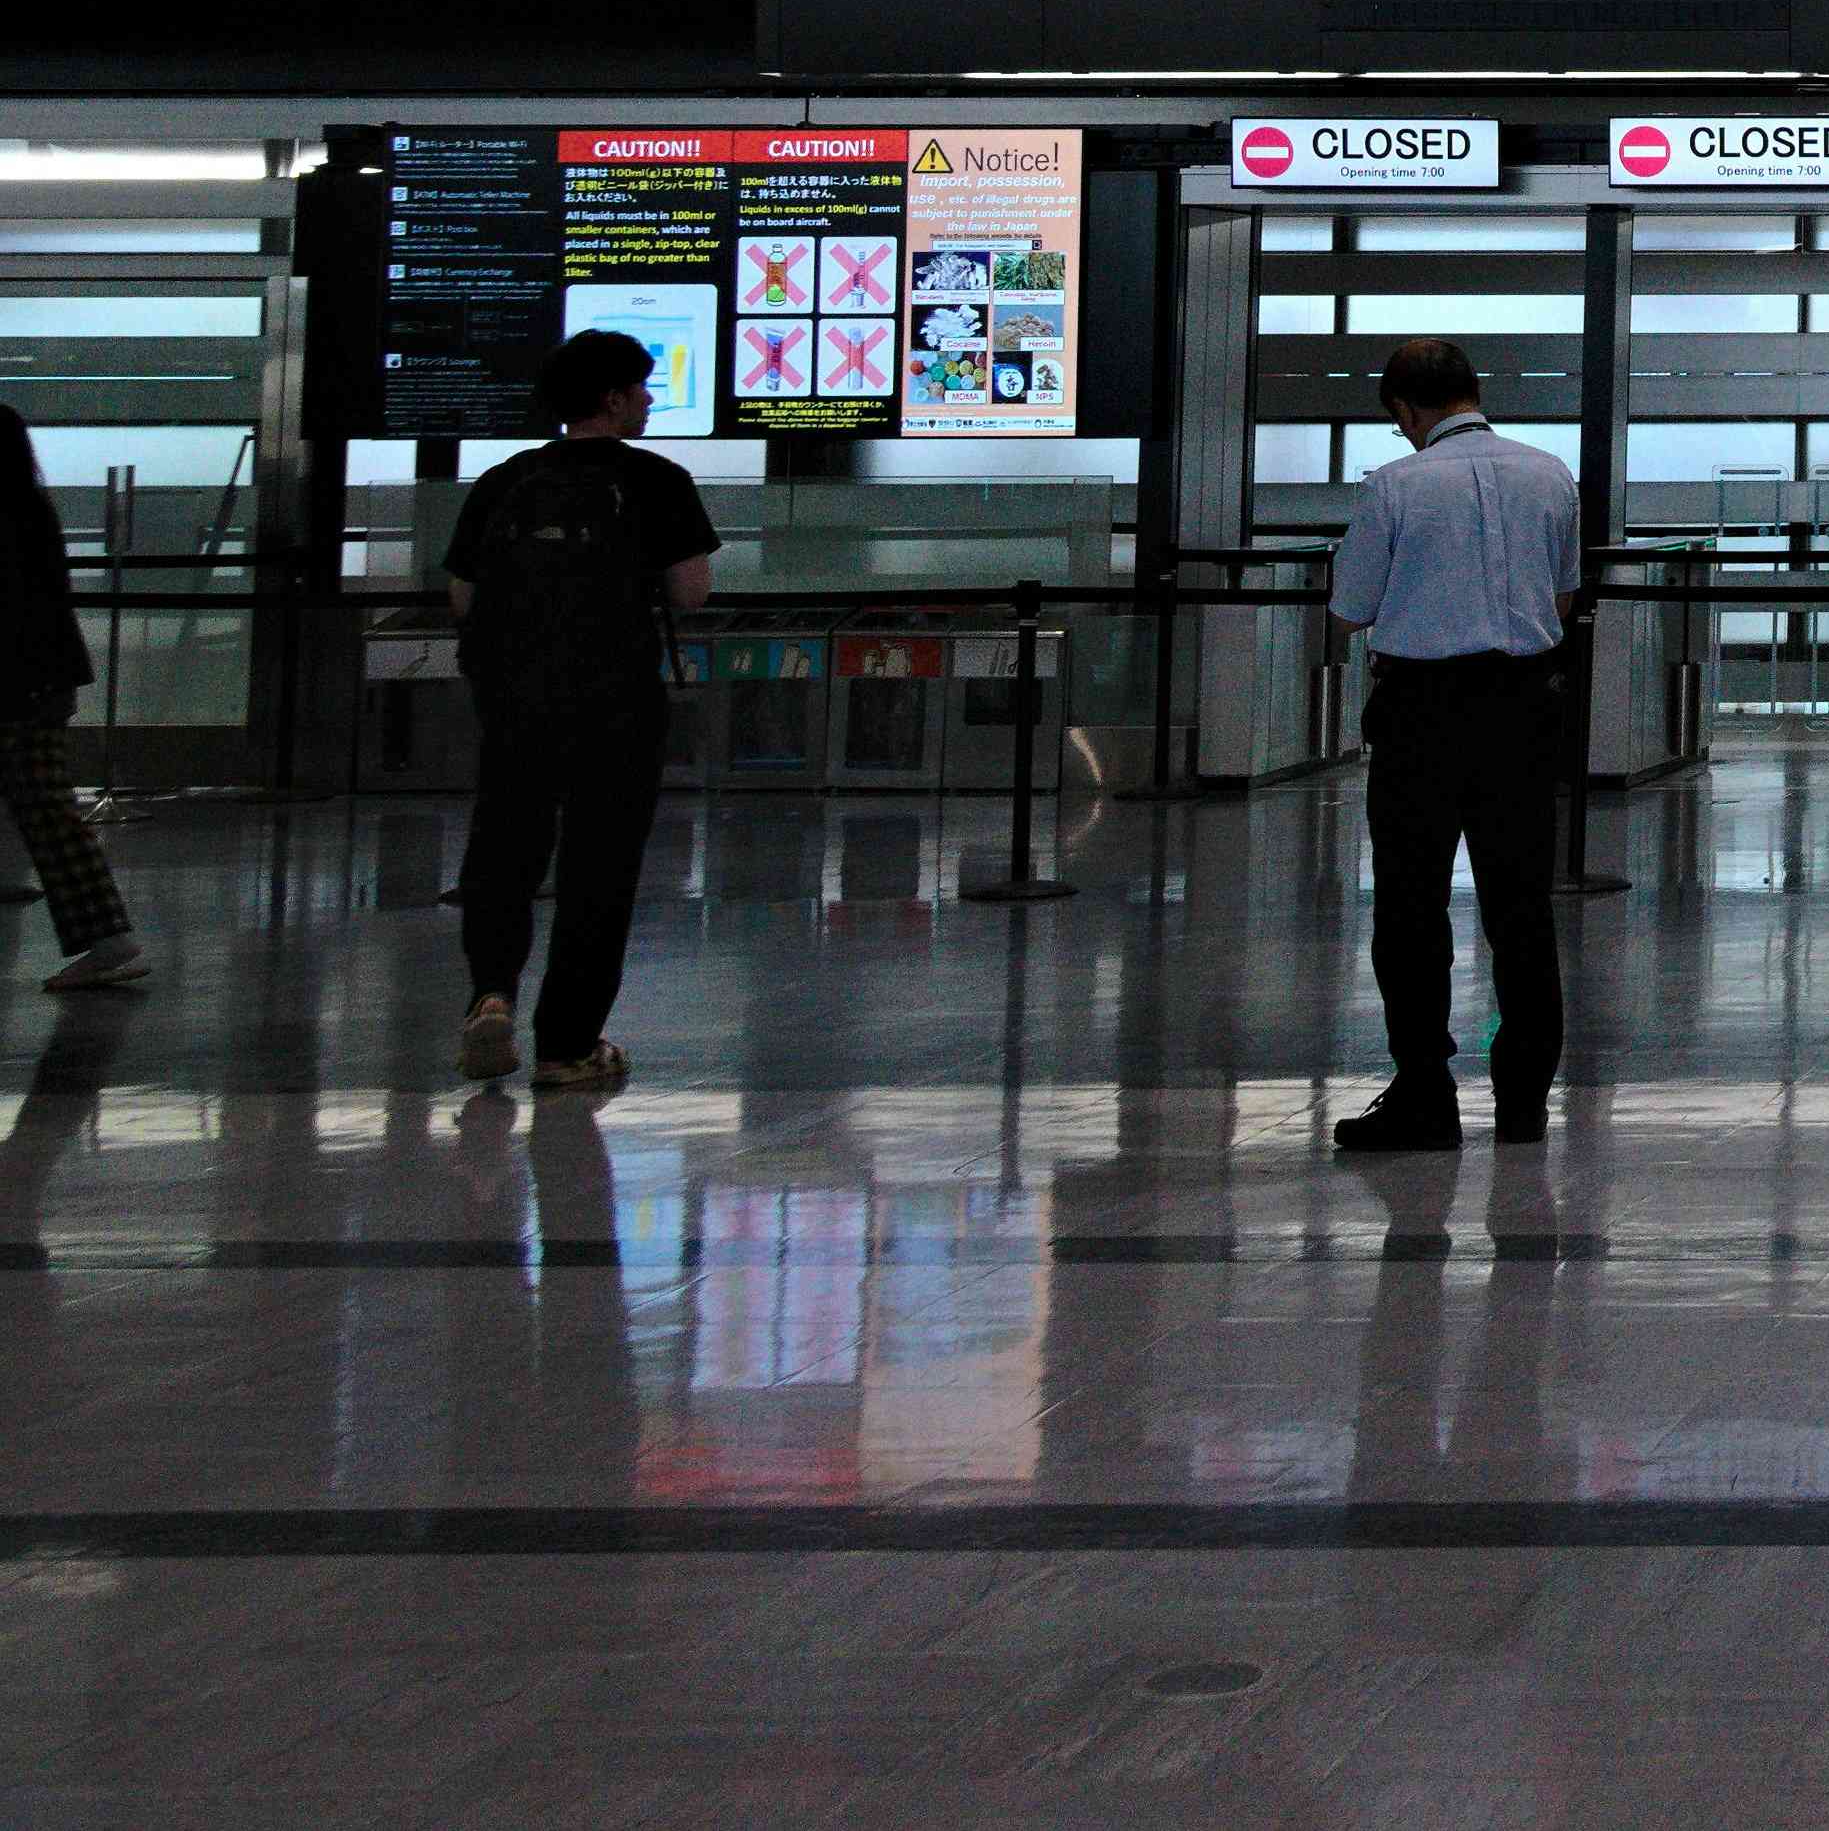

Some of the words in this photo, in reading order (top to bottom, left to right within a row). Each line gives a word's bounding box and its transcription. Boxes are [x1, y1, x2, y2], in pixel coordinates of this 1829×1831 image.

[593, 136, 701, 158] CAUTION!!
[766, 135, 879, 160] CAUTION!!
[1312, 127, 1471, 160] CLOSED
[964, 143, 1059, 173] Notice!
[1340, 166, 1388, 179] Opening
[1390, 168, 1417, 178] time
[1421, 166, 1445, 178] 7:00
